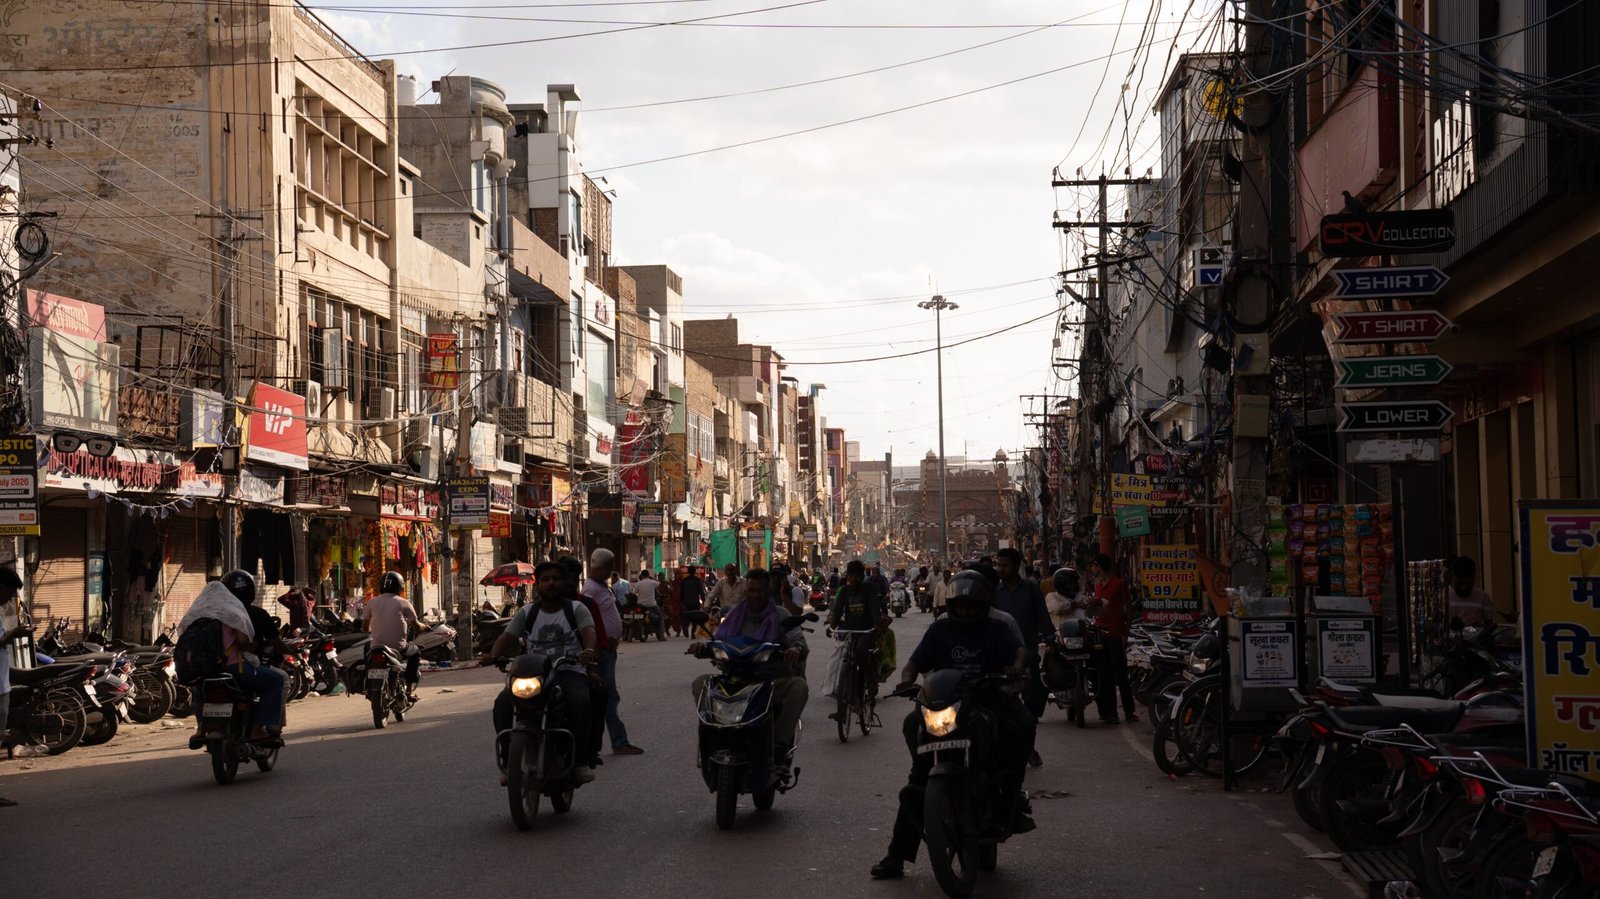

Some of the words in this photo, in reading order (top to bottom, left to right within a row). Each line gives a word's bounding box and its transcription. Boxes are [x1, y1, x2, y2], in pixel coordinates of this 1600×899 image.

[1322, 220, 1384, 246] CRV
[1383, 226, 1455, 241] COLLECTION
[1355, 274, 1429, 290] SHIRT
[1358, 321, 1370, 334] T
[1375, 319, 1429, 333] SHIRT
[1365, 363, 1426, 379] JEANS
[265, 401, 293, 435] VIP
[1364, 409, 1429, 424] LOWER
[68, 450, 105, 479] OPTICAL
[1547, 516, 1600, 553] ह
[1269, 635, 1290, 643] कचरा
